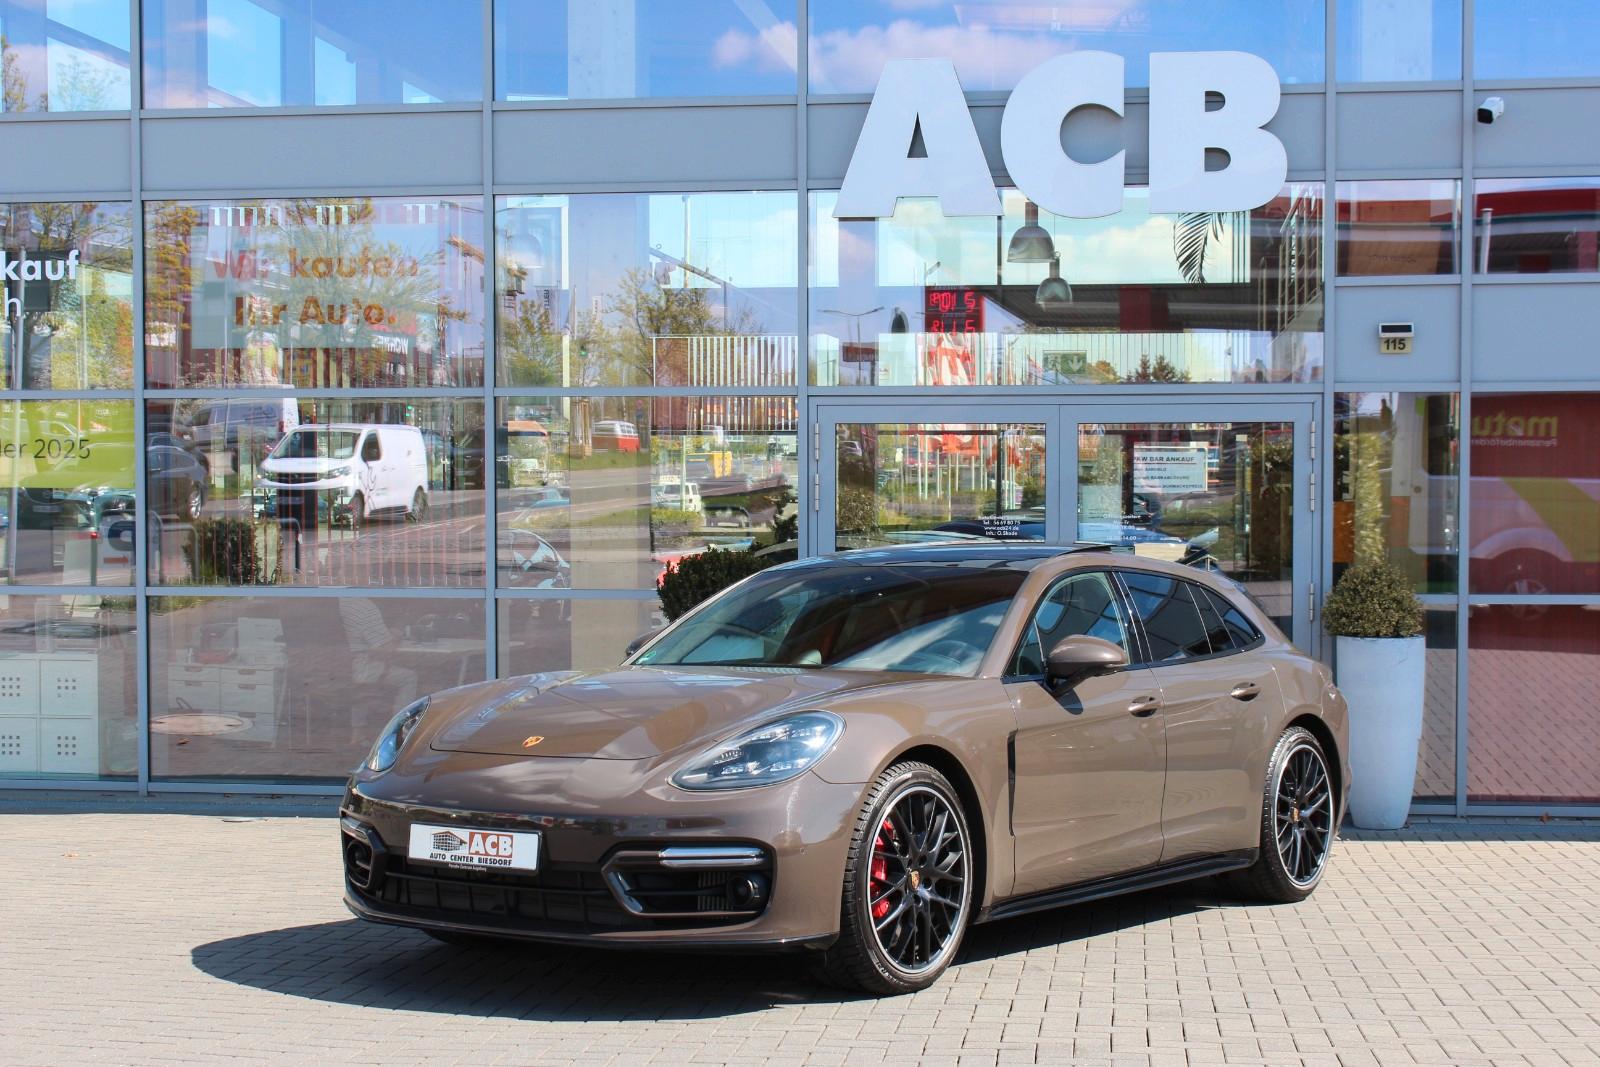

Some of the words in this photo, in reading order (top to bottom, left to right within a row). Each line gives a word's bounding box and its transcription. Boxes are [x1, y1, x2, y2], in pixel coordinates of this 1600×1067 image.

[832, 50, 1288, 219] ACB
[0, 249, 79, 281] kauf
[1384, 338, 1406, 350] 115
[34, 439, 91, 459] 2025
[469, 833, 512, 856] ACB
[430, 852, 446, 860] AUTO
[450, 854, 474, 863] CENTER
[478, 856, 512, 866] BIESDORF
